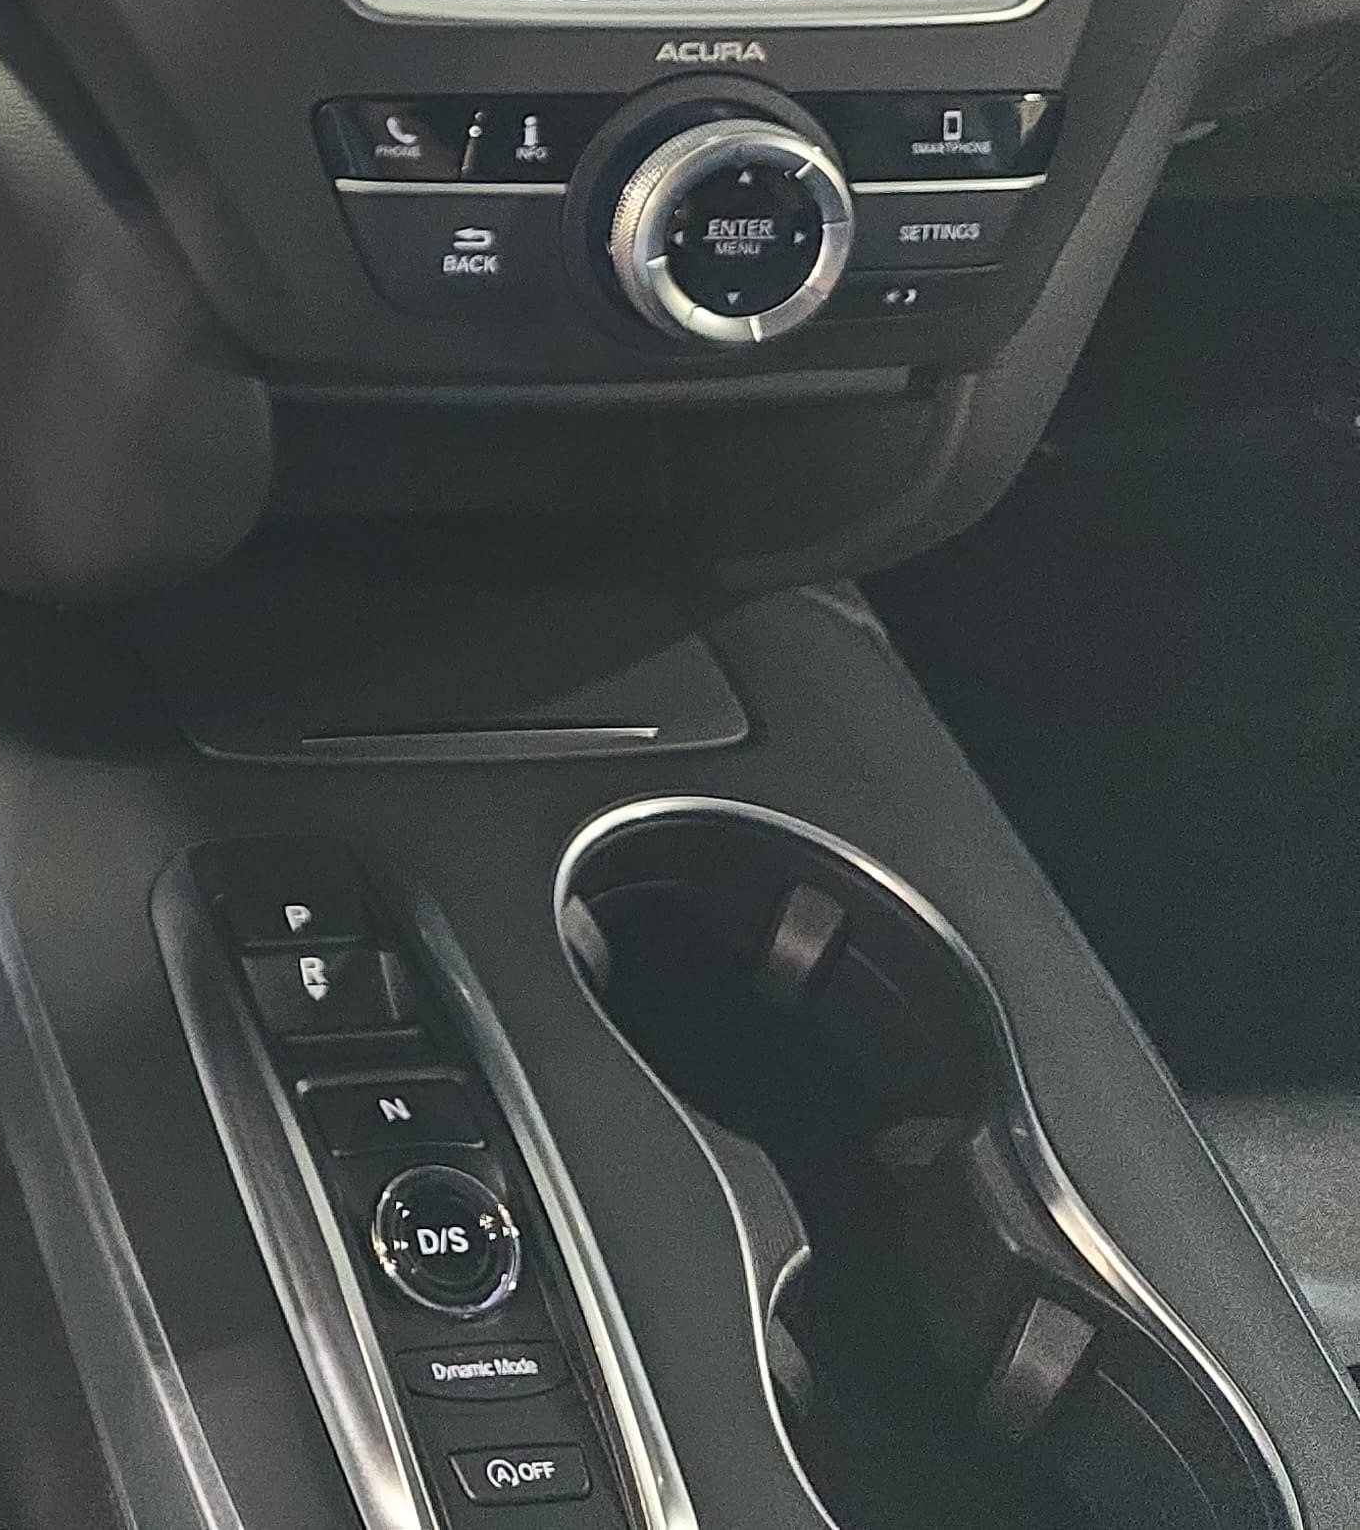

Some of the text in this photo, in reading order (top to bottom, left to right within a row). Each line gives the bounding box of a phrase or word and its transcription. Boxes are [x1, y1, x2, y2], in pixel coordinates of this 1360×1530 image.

[655, 41, 766, 62] ACURA
[707, 218, 774, 237] ENTER
[898, 222, 981, 242] SETTINGS
[714, 241, 761, 256] MENU
[442, 254, 499, 274] BACK
[284, 904, 312, 932] P
[299, 956, 328, 984] R
[379, 1097, 412, 1123] N
[416, 1226, 470, 1256] D/S
[431, 1356, 539, 1381] Dynamic Mode
[518, 1461, 556, 1481] OFF
